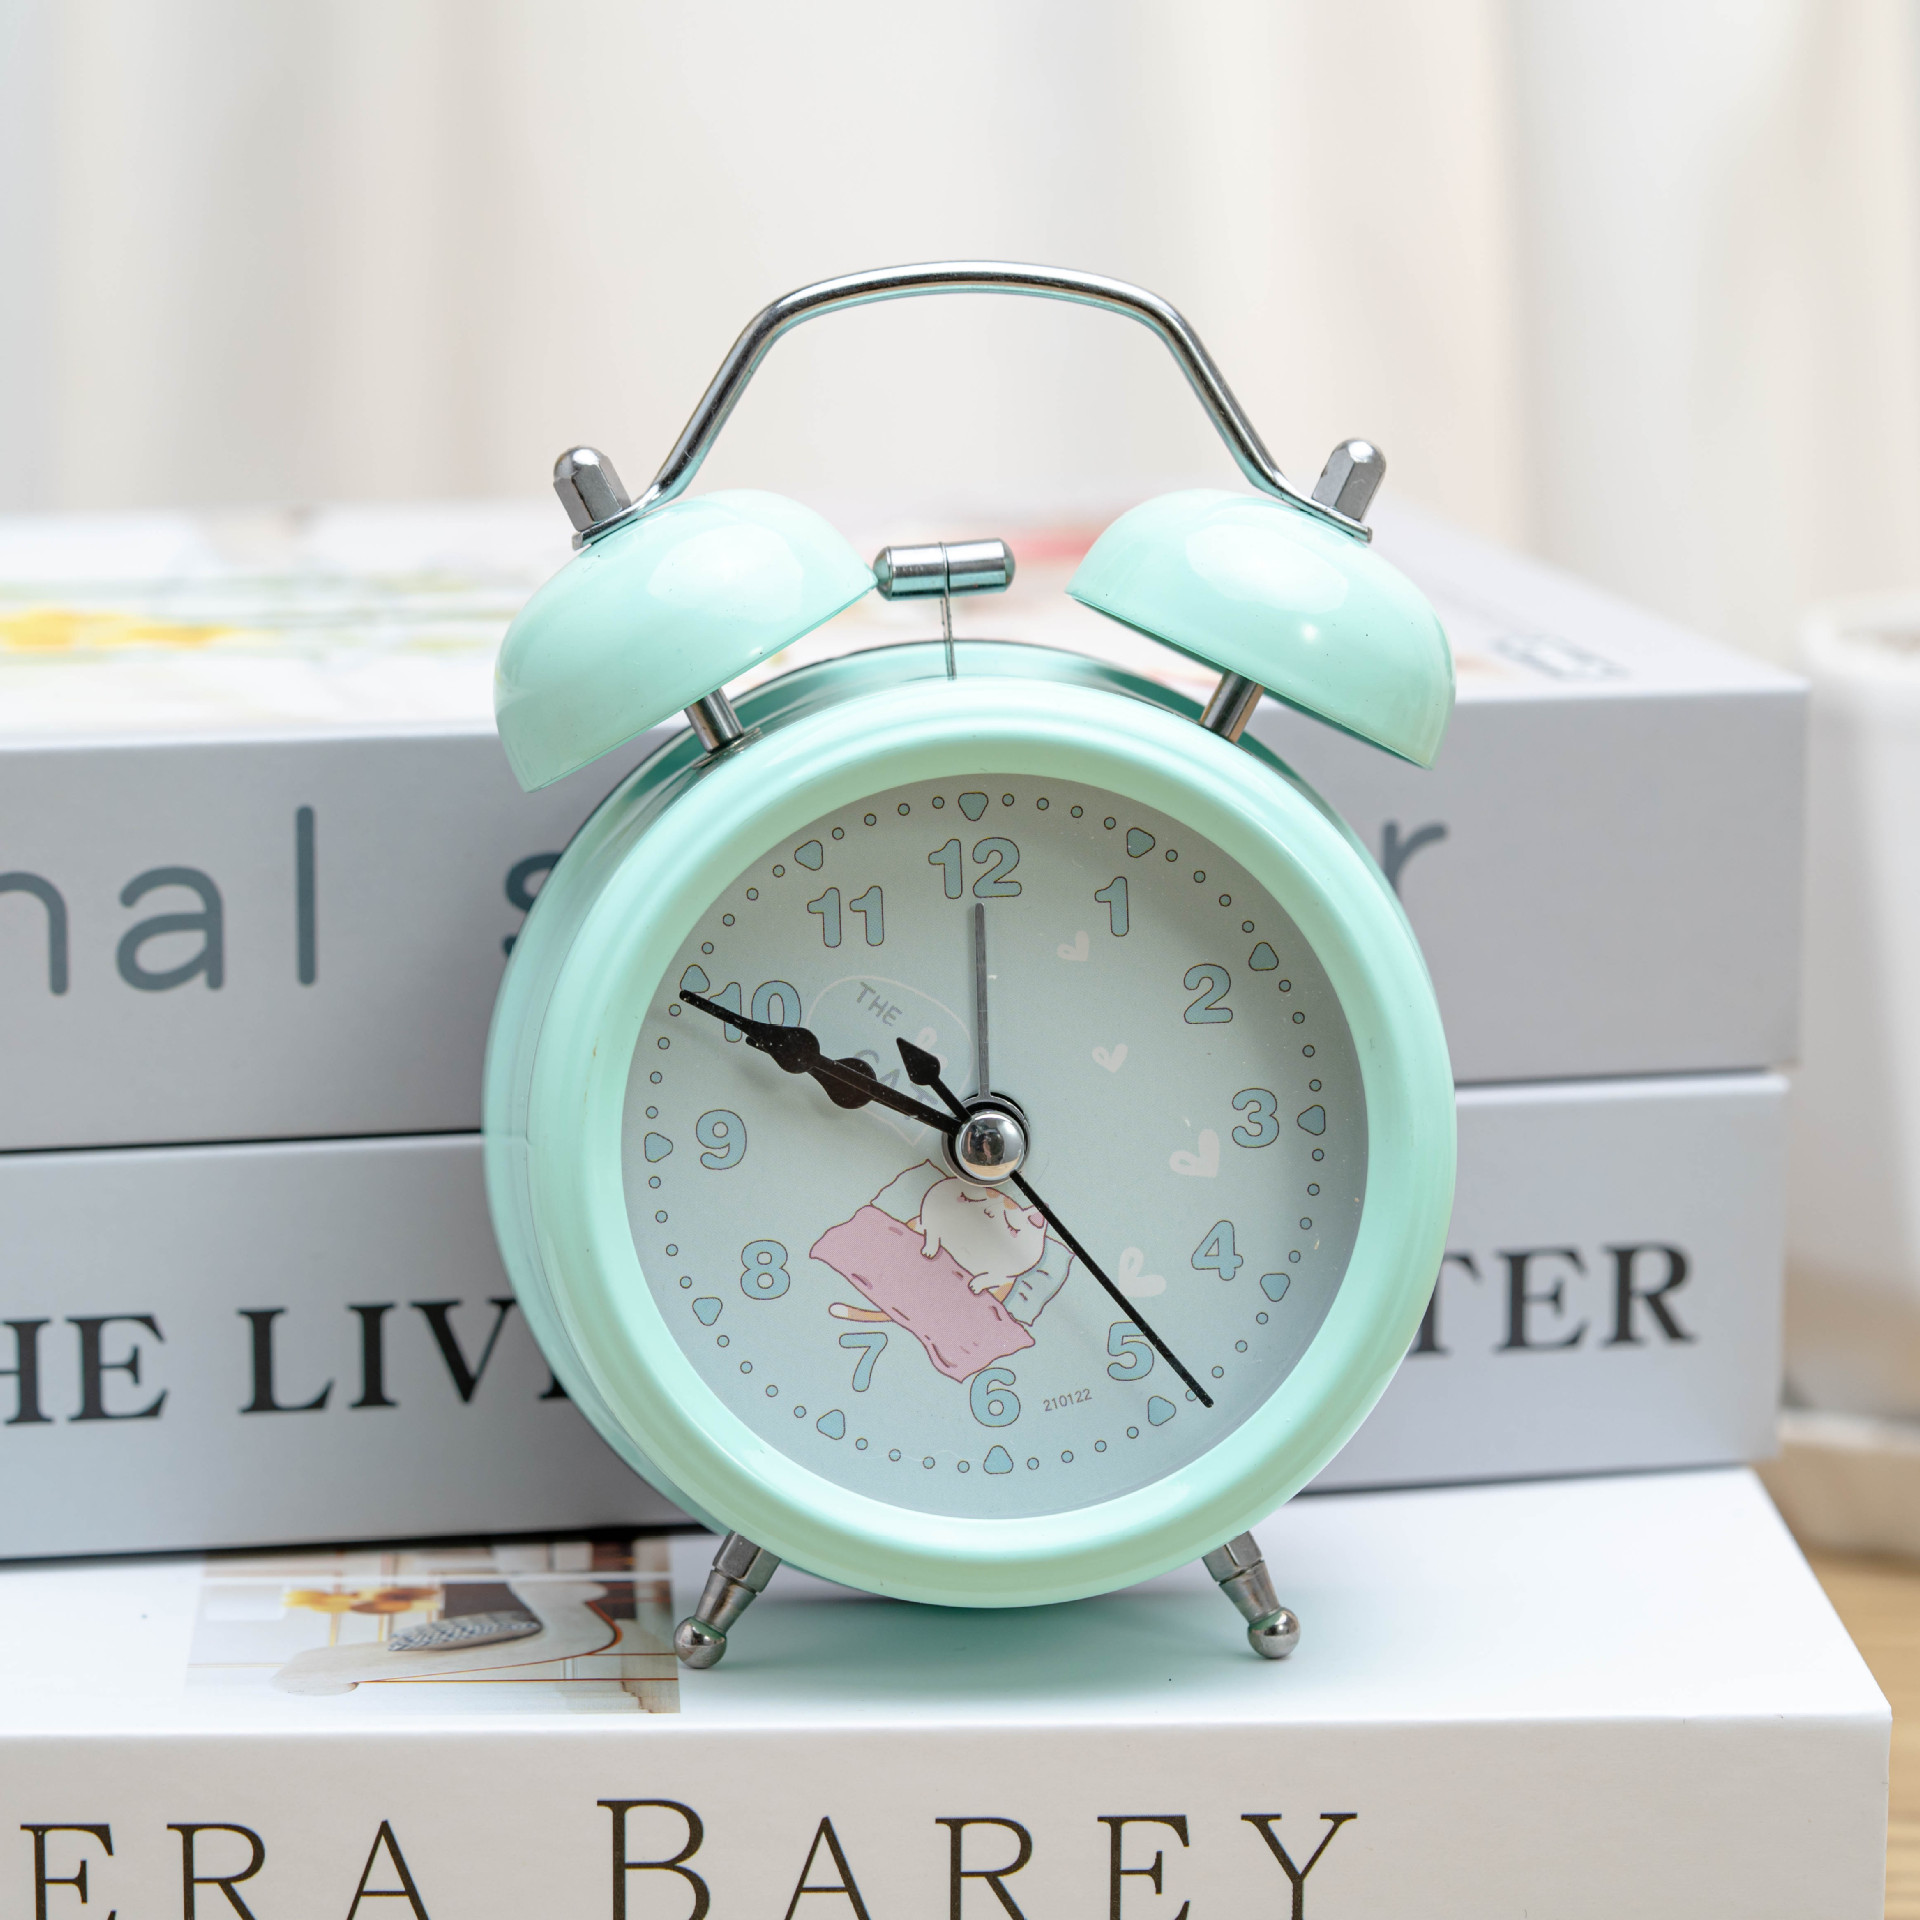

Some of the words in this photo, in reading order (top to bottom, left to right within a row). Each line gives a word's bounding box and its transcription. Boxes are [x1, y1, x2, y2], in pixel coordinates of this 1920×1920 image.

[929, 837, 1022, 899] 12
[807, 886, 885, 948] 11
[1095, 876, 1129, 937] 1
[707, 980, 802, 1043] 10
[855, 981, 903, 1027] THE
[1183, 963, 1234, 1025] 2
[695, 1109, 748, 1171] 9
[1231, 1088, 1280, 1149] 3
[740, 1240, 791, 1301] 8
[1190, 1220, 1244, 1282] 4
[237, 1297, 570, 1417] LIV
[838, 1332, 888, 1392] 7
[1106, 1321, 1155, 1382] 5
[969, 1367, 1021, 1428] 6
[1043, 1388, 1093, 1412] 210122
[596, 1799, 1358, 1920] BAREY
